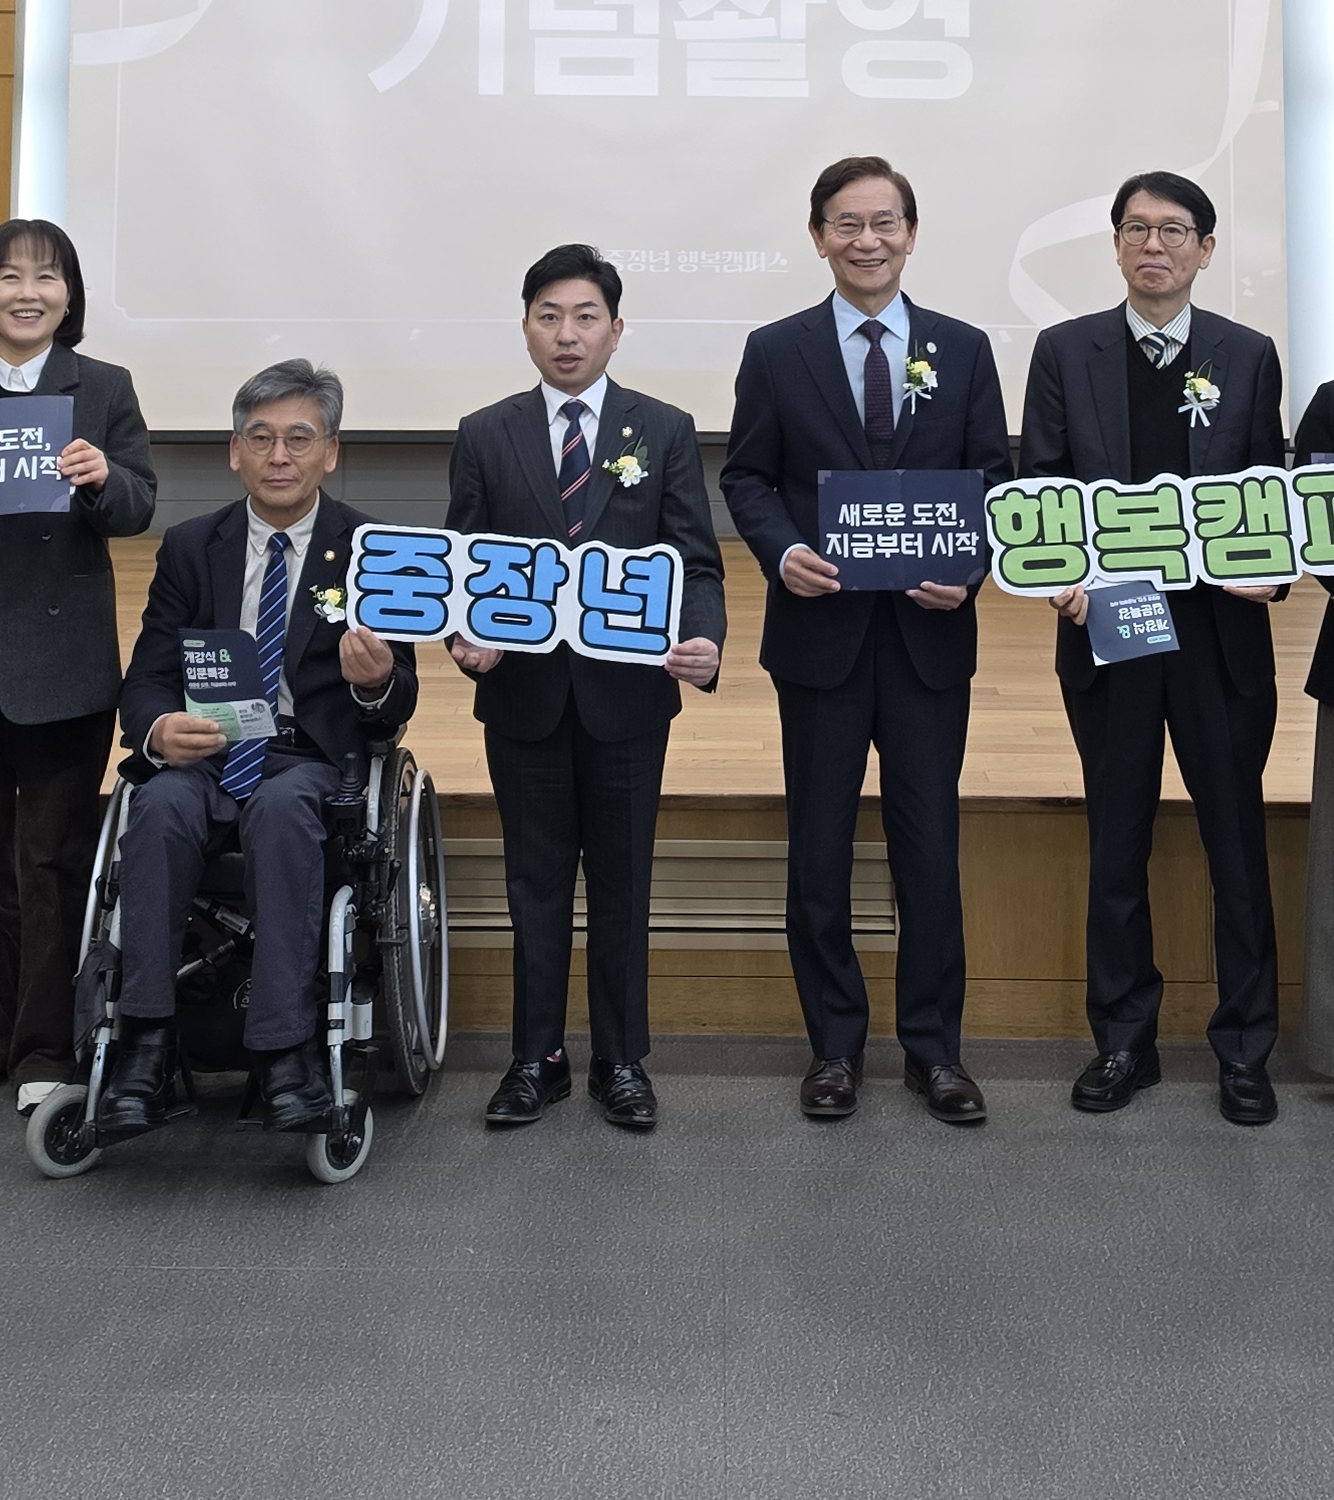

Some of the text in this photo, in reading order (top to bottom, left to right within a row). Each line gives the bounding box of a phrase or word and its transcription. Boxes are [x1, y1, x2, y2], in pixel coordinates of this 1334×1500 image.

[676, 249, 789, 274] 행복캠퍼스
[12, 455, 63, 481] 시작
[838, 502, 966, 529] 새로운 도전,
[825, 531, 980, 560] 지금부터 시작
[355, 528, 677, 655] 중장년
[1118, 603, 1165, 621] 입문특강
[1116, 618, 1170, 639] 개강식 &
[183, 648, 232, 664] 개강식 &
[186, 666, 229, 680] 입문특강
